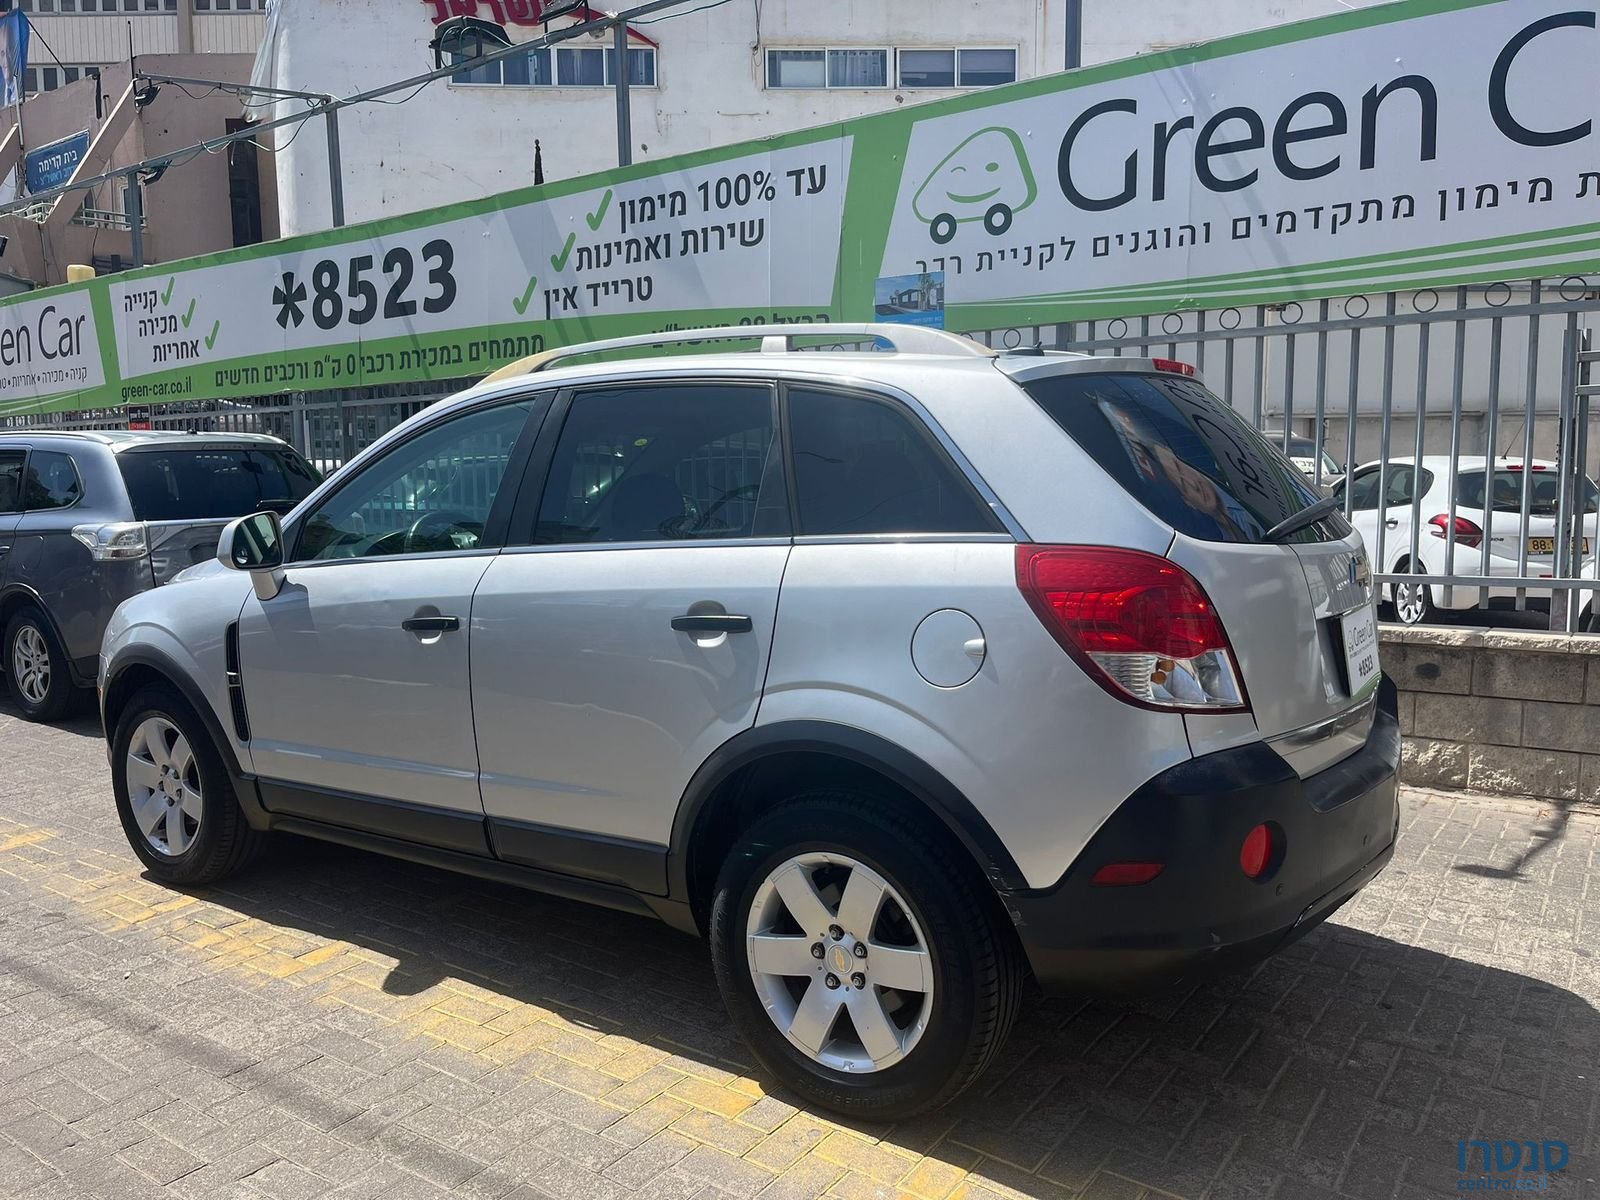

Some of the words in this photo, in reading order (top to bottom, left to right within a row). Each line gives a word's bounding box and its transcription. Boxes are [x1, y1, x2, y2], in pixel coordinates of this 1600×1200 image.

[64, 150, 78, 164] בית
[1057, 74, 1438, 212] Green
[38, 155, 62, 173] קדימה
[697, 170, 776, 212] 100%
[786, 164, 827, 197] עד
[619, 190, 687, 234] מימון
[1437, 177, 1553, 221] מימון
[1231, 194, 1415, 240] מתקדמים
[576, 232, 671, 272] ואמינות
[680, 218, 765, 257] שירות
[1092, 221, 1211, 258] והוגנים
[975, 236, 1076, 272] לקניית
[124, 290, 158, 314] קנייה
[544, 285, 578, 320] אין
[586, 275, 653, 307] טרייד
[39, 305, 85, 360] Car
[138, 314, 178, 338] מכירה
[152, 339, 200, 363] אחריות
[360, 352, 394, 374] רכבי
[399, 344, 463, 370] במכירת
[469, 334, 544, 362] מתמחים
[215, 367, 260, 387] חדשים
[264, 361, 309, 382] ורכבים
[346, 353, 356, 375] 0
[12, 373, 37, 388] אחריות
[121, 375, 192, 402] green-car.co.il
